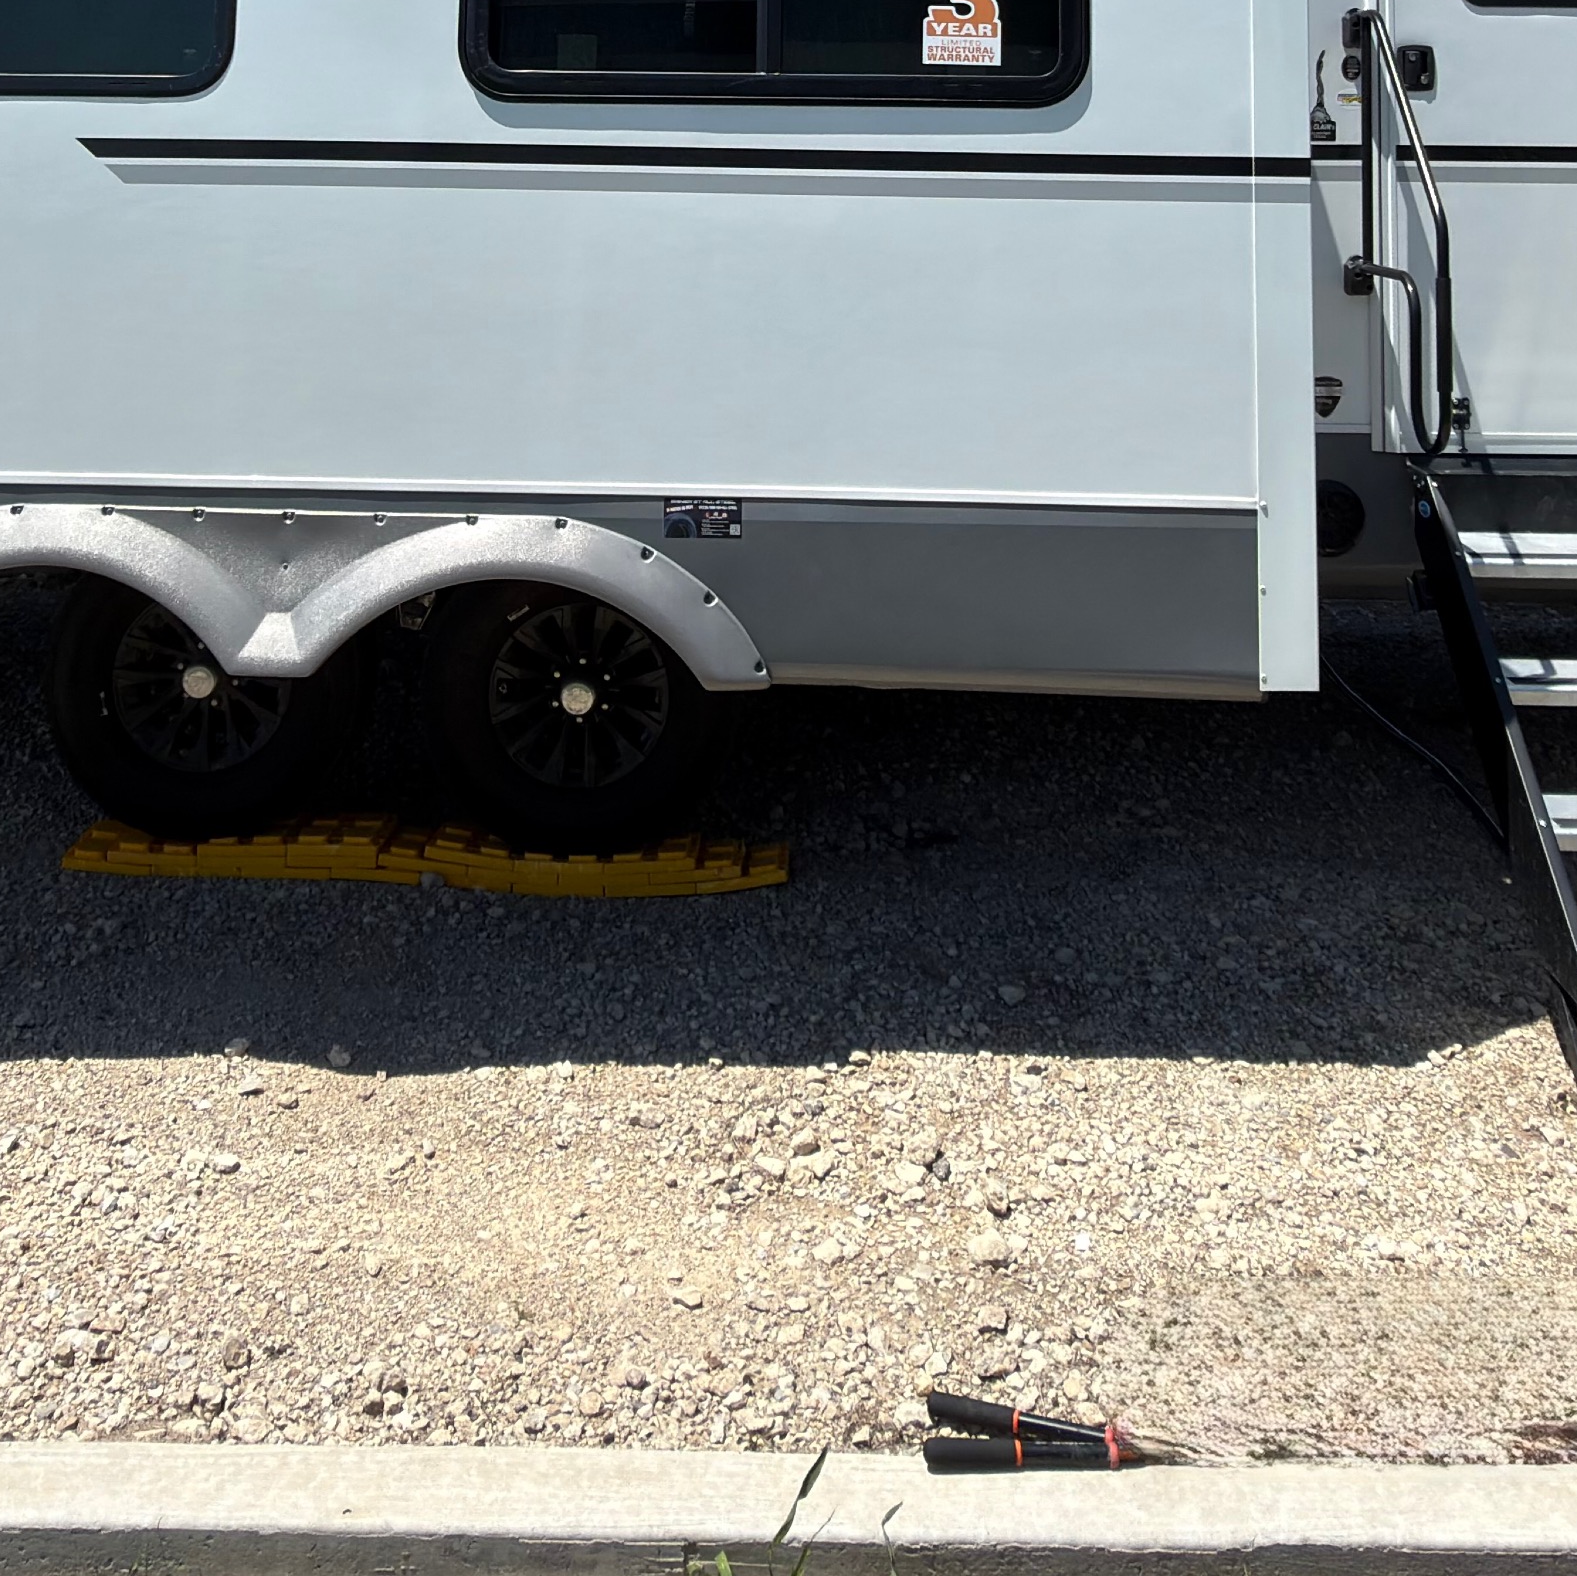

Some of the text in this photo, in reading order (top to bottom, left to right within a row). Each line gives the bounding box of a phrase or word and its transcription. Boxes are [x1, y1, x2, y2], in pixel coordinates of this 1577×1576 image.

[930, 22, 993, 37] YEAR
[927, 45, 996, 55] STRUCTURAL
[927, 53, 996, 63] WARRANTY
